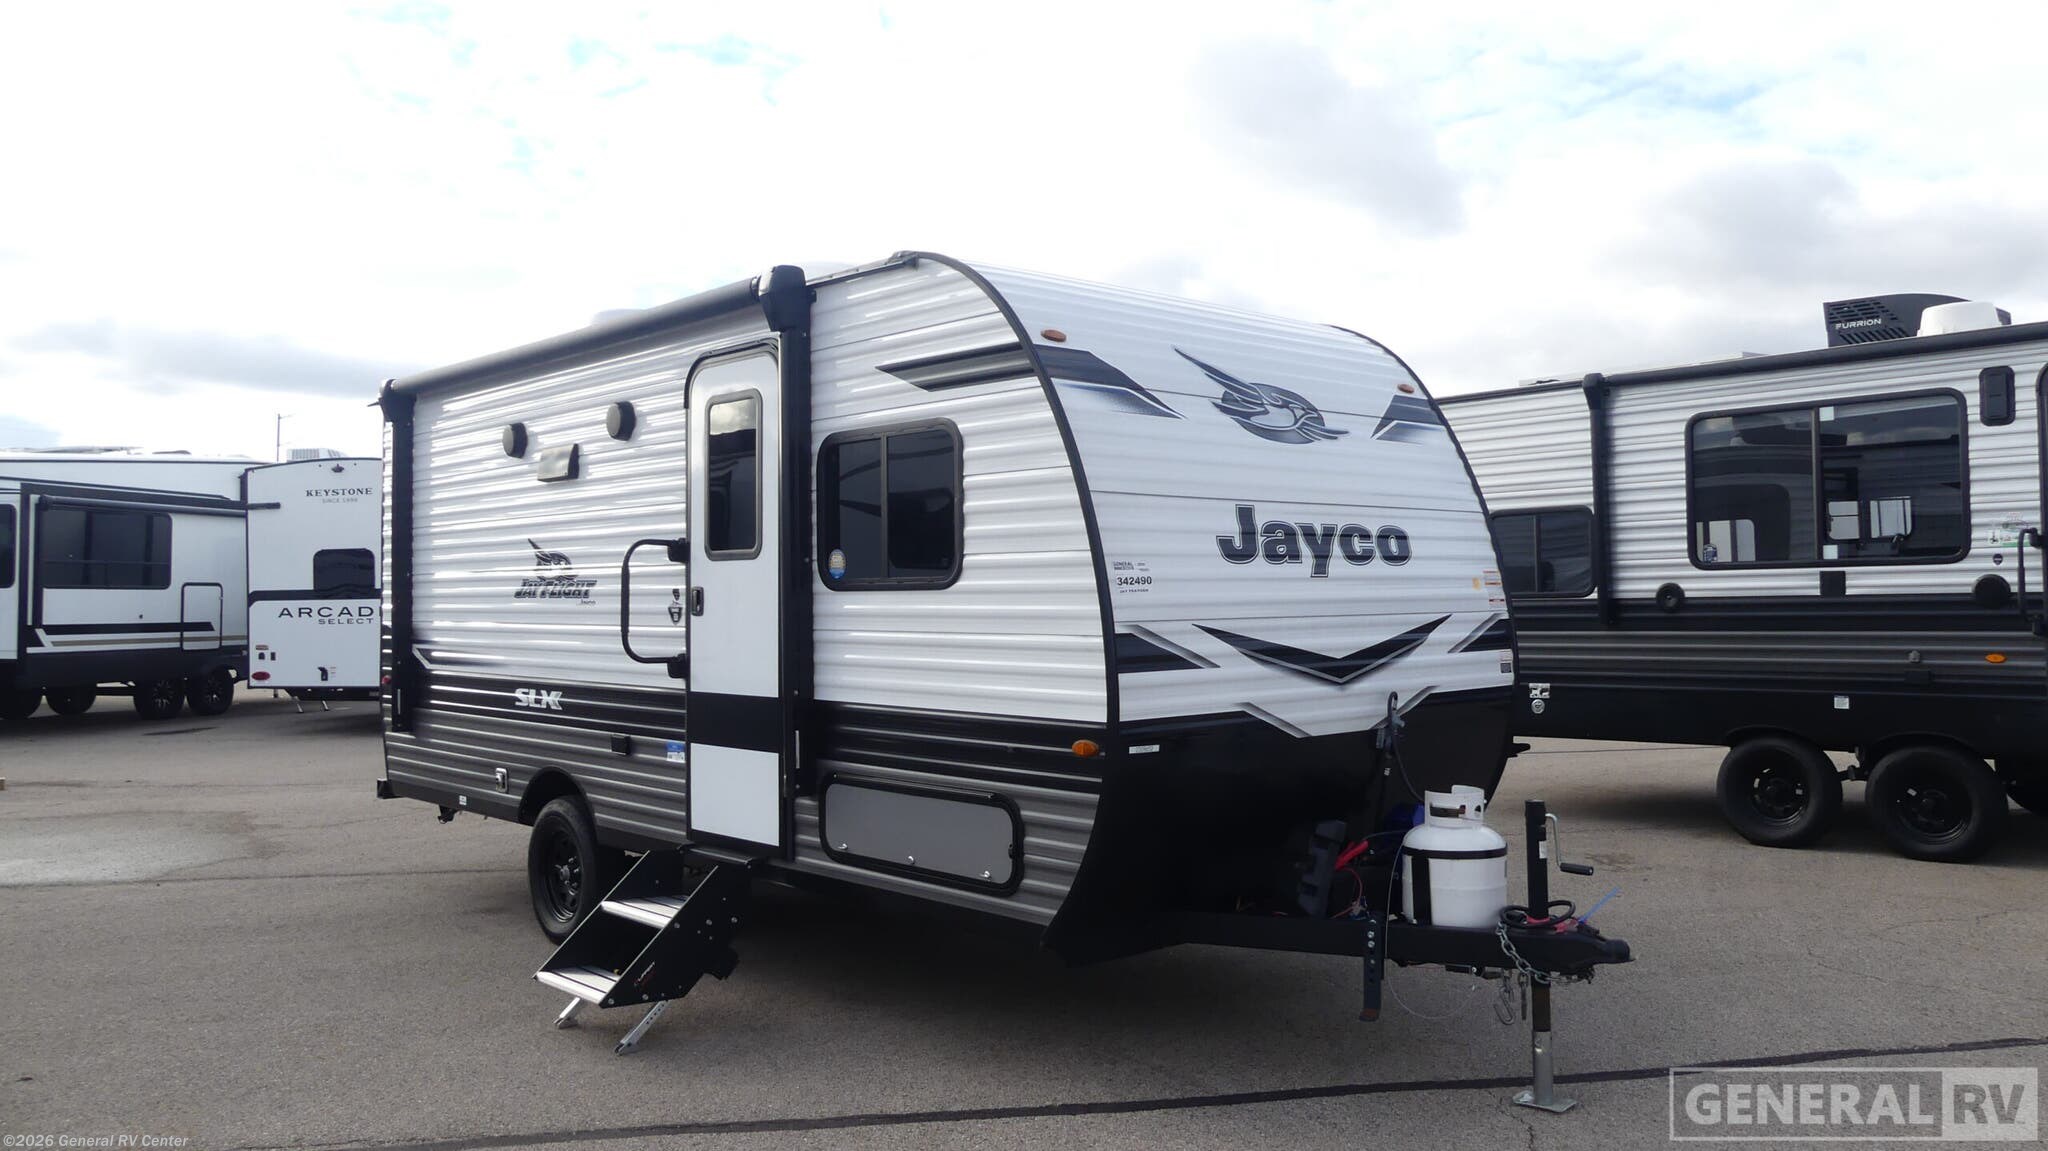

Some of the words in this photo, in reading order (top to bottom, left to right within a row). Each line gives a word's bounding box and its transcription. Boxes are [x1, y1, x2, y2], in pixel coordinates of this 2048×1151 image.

[1835, 318, 1882, 330] FURRION
[305, 487, 373, 497] KEYSTONE
[1216, 504, 1413, 578] Jayco
[1116, 576, 1152, 586] 342490
